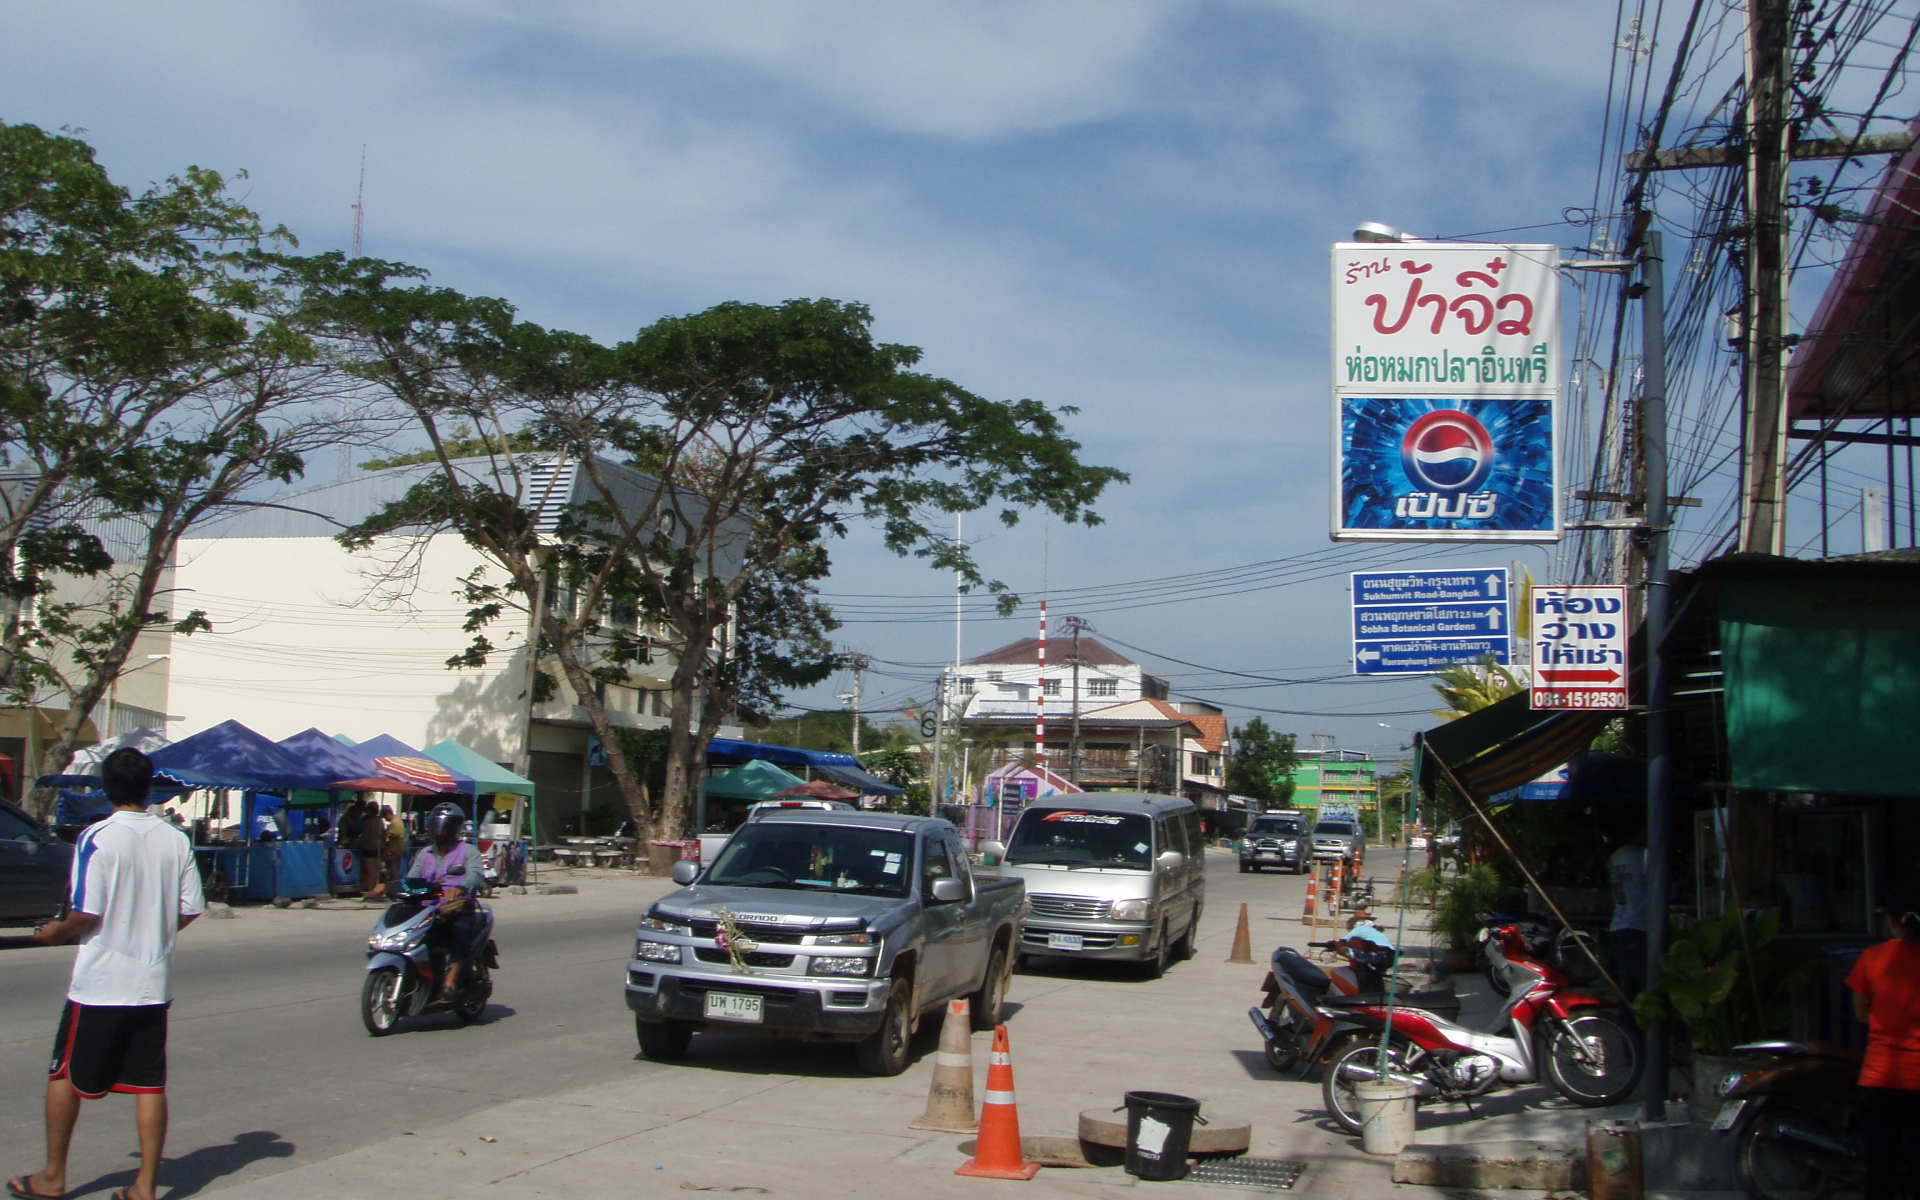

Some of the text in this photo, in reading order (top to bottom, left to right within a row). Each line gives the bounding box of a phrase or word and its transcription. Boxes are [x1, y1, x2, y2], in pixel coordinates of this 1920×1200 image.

[1346, 257, 1391, 284] ร้าน
[1365, 256, 1534, 336] ป้าจิ๋ว
[1346, 342, 1547, 383] ห่อหมกปลาอินทรี
[1395, 490, 1498, 519] เป๊ปซี่
[1363, 591, 1412, 601] Sukhumvit
[1535, 591, 1621, 614] ห้อง
[1361, 622, 1476, 634] Sobha Botanical Gardens
[1541, 617, 1616, 639] ว่าง
[1536, 641, 1622, 664] ให้เช่า
[732, 997, 759, 1011] 1795
